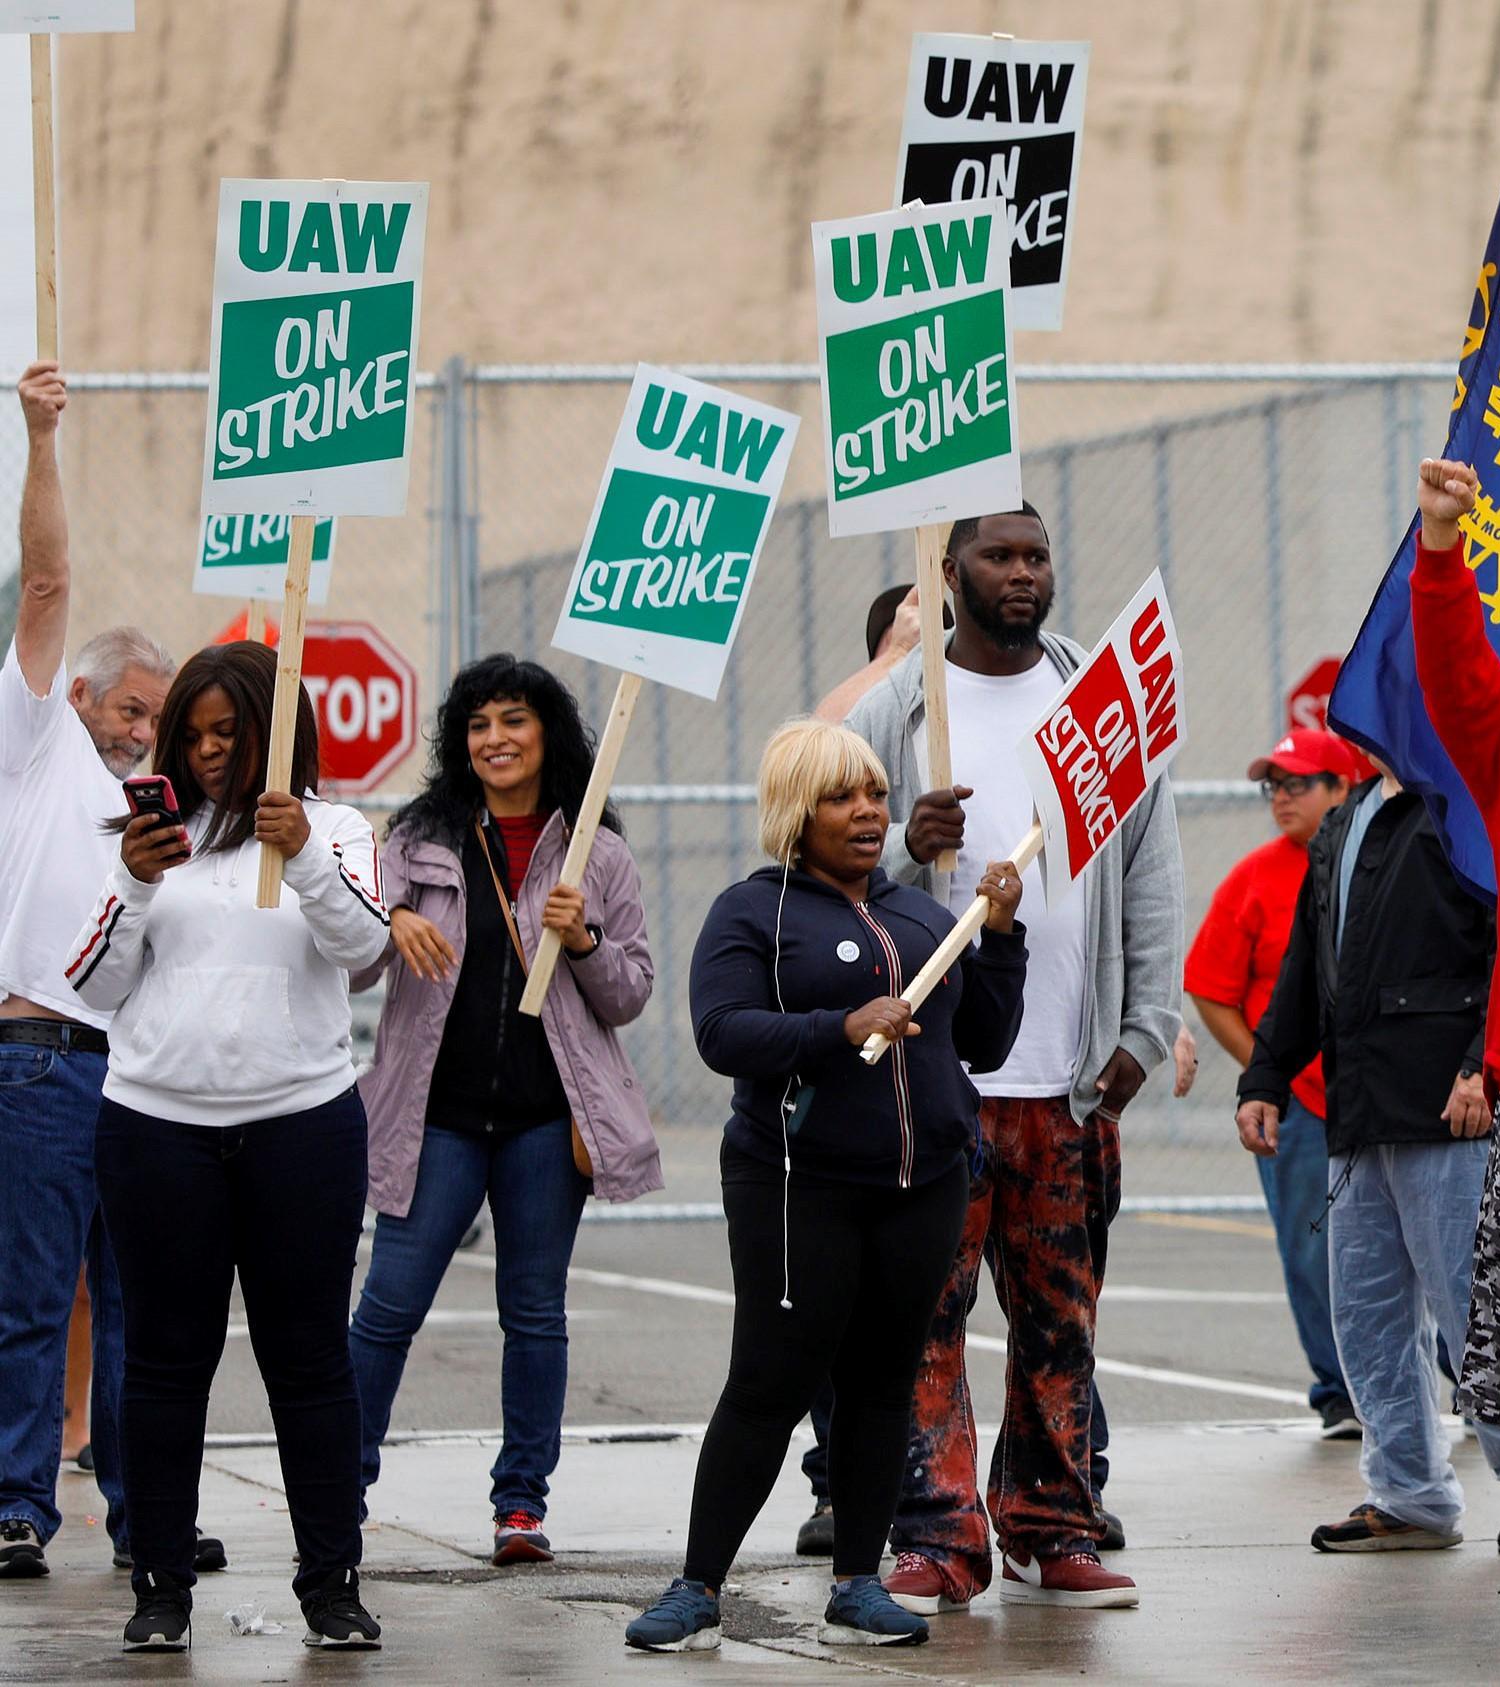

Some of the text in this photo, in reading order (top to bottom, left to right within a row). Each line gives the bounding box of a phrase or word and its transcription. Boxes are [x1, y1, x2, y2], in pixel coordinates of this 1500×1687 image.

[924, 56, 1074, 123] UAW
[951, 146, 1020, 201] ON
[239, 200, 411, 273] UAW
[831, 215, 991, 303] UAW
[275, 300, 351, 380] ON
[879, 314, 946, 398] ON
[217, 349, 408, 472] STRIKE
[636, 385, 784, 482] UAW
[834, 353, 1006, 492] STRIKE
[206, 514, 331, 561] STRI
[642, 494, 715, 550] ON
[579, 551, 751, 614] STRIKE
[1130, 598, 1178, 763] UAW
[1095, 700, 1136, 774] ON
[1041, 704, 1117, 851] STRIKE
